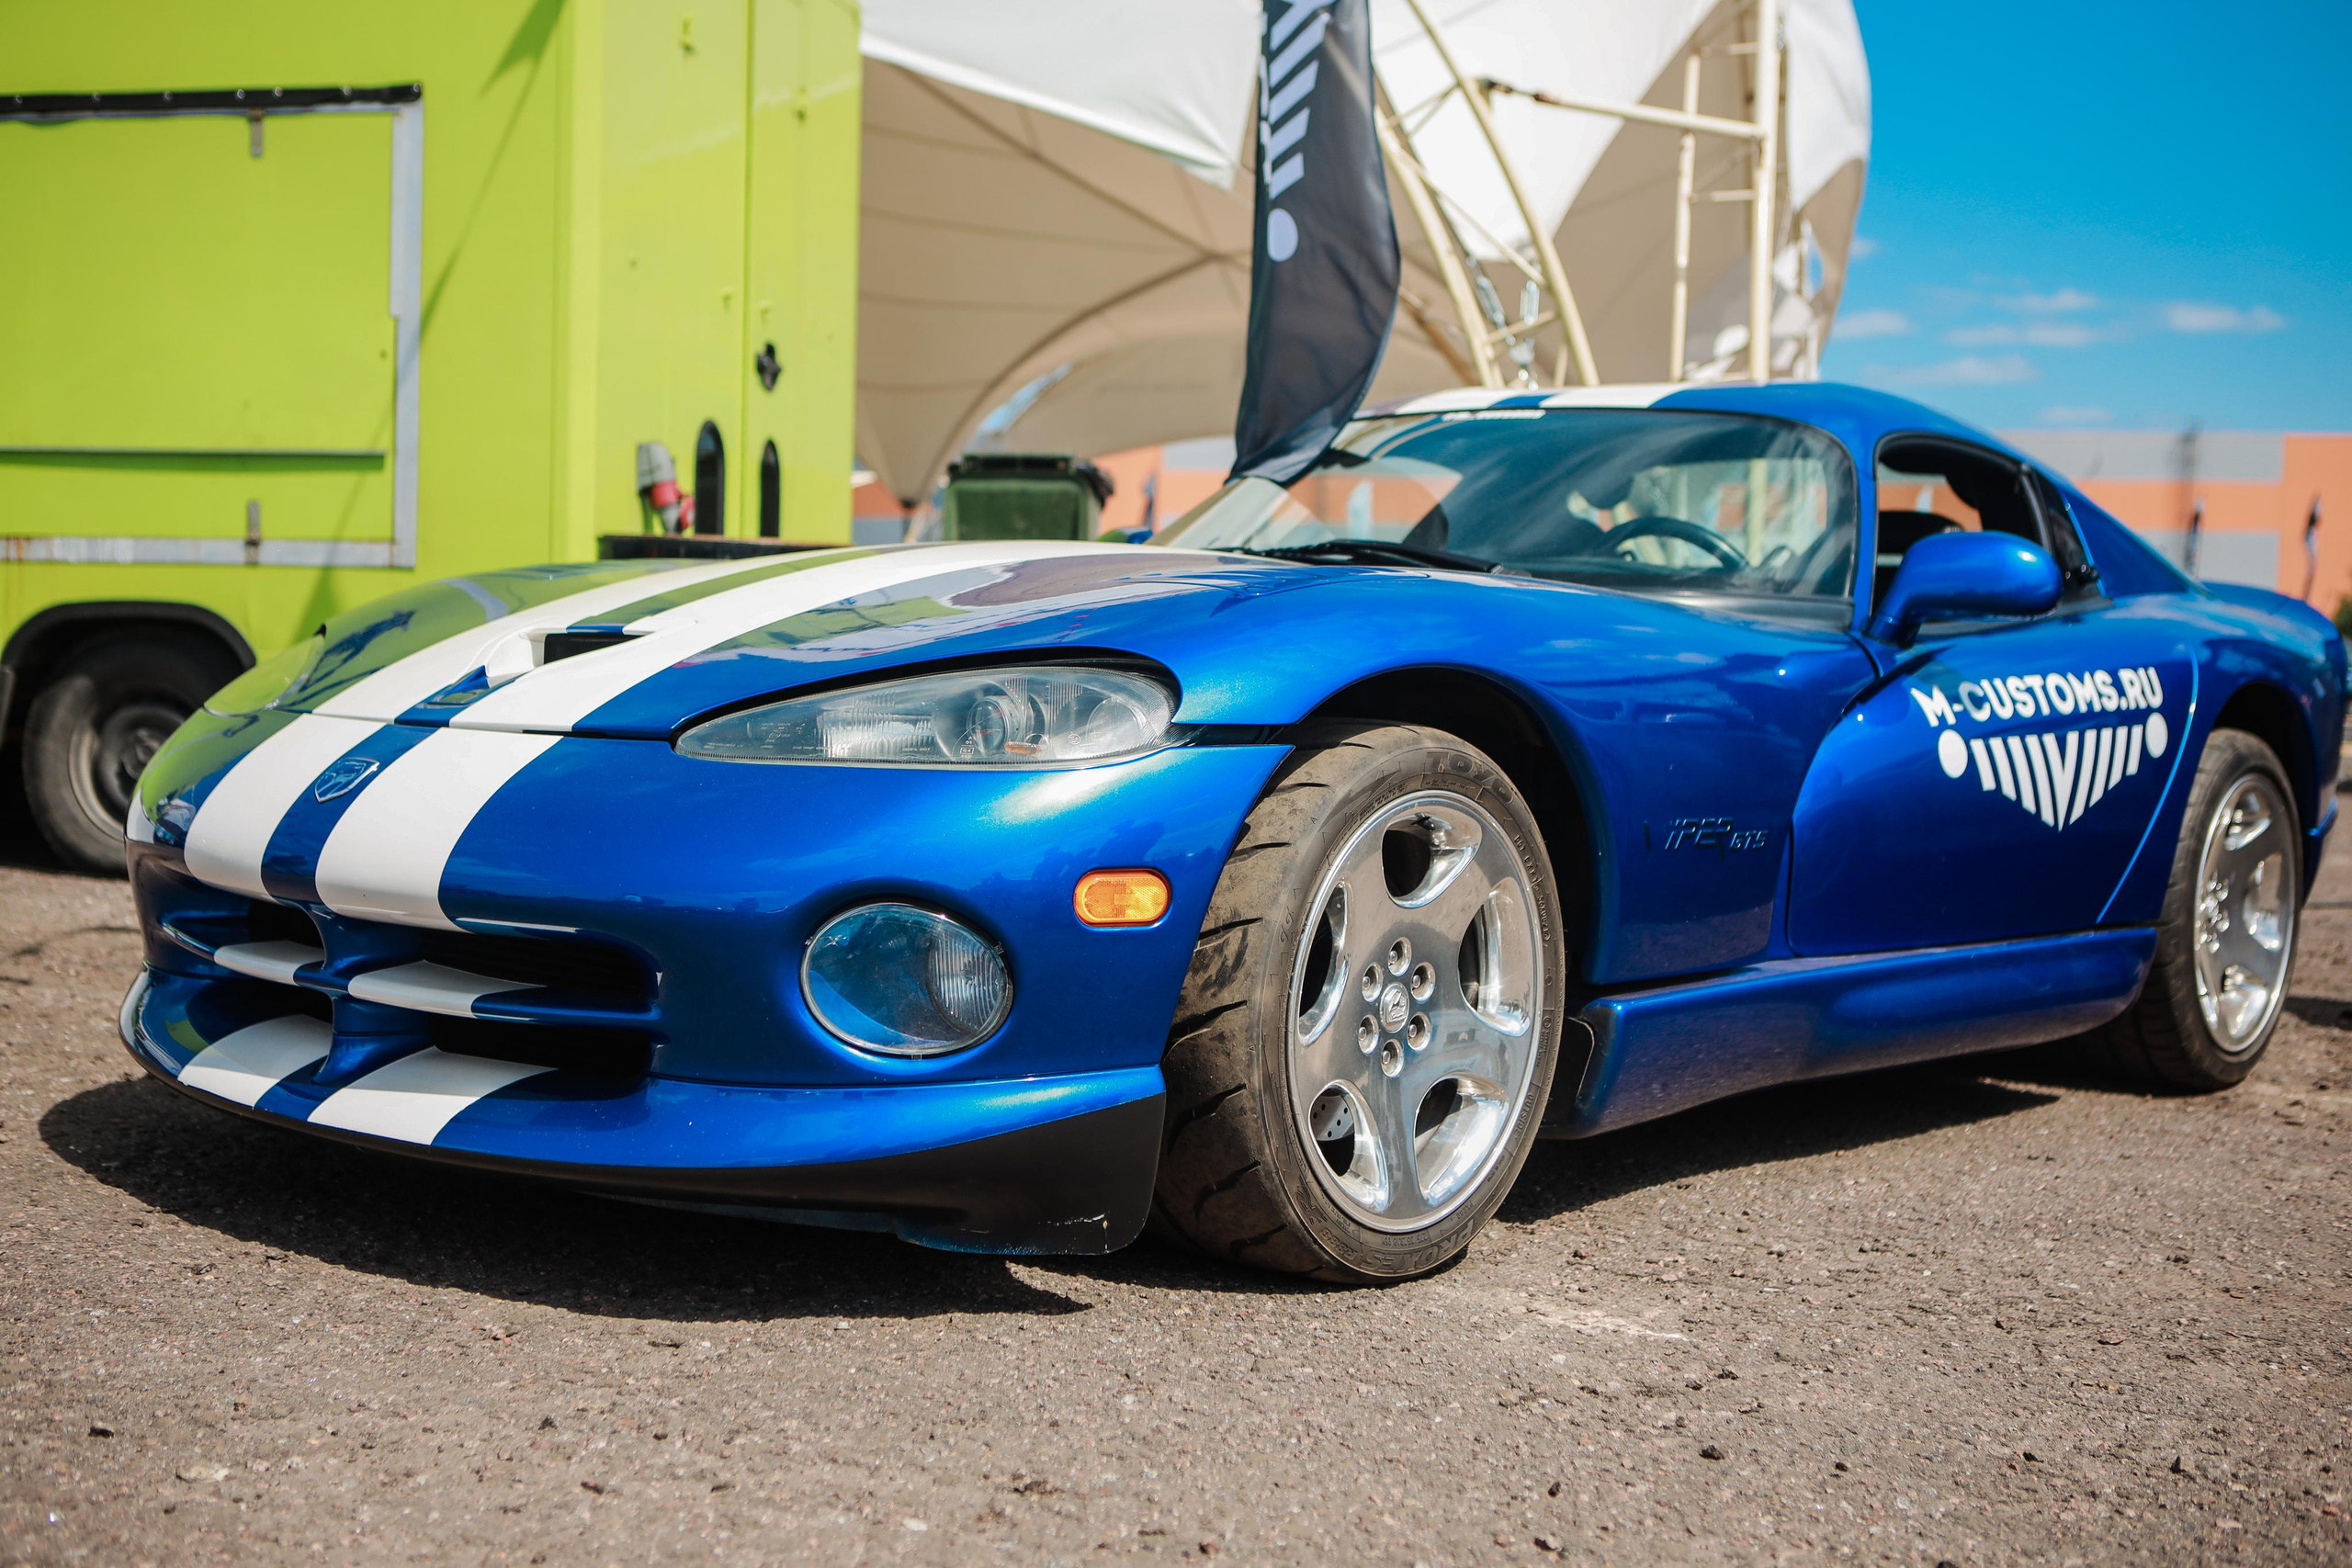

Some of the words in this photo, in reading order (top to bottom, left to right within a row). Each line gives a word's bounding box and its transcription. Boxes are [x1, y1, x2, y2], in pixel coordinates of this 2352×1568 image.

[1910, 667, 2163, 728] M-CUSTOMS.RU
[1425, 751, 1514, 804] TOYO
[1514, 1092, 1535, 1137] OUTSIDE
[1319, 1229, 1359, 1259] R888
[1362, 1218, 1475, 1272] PROXES
